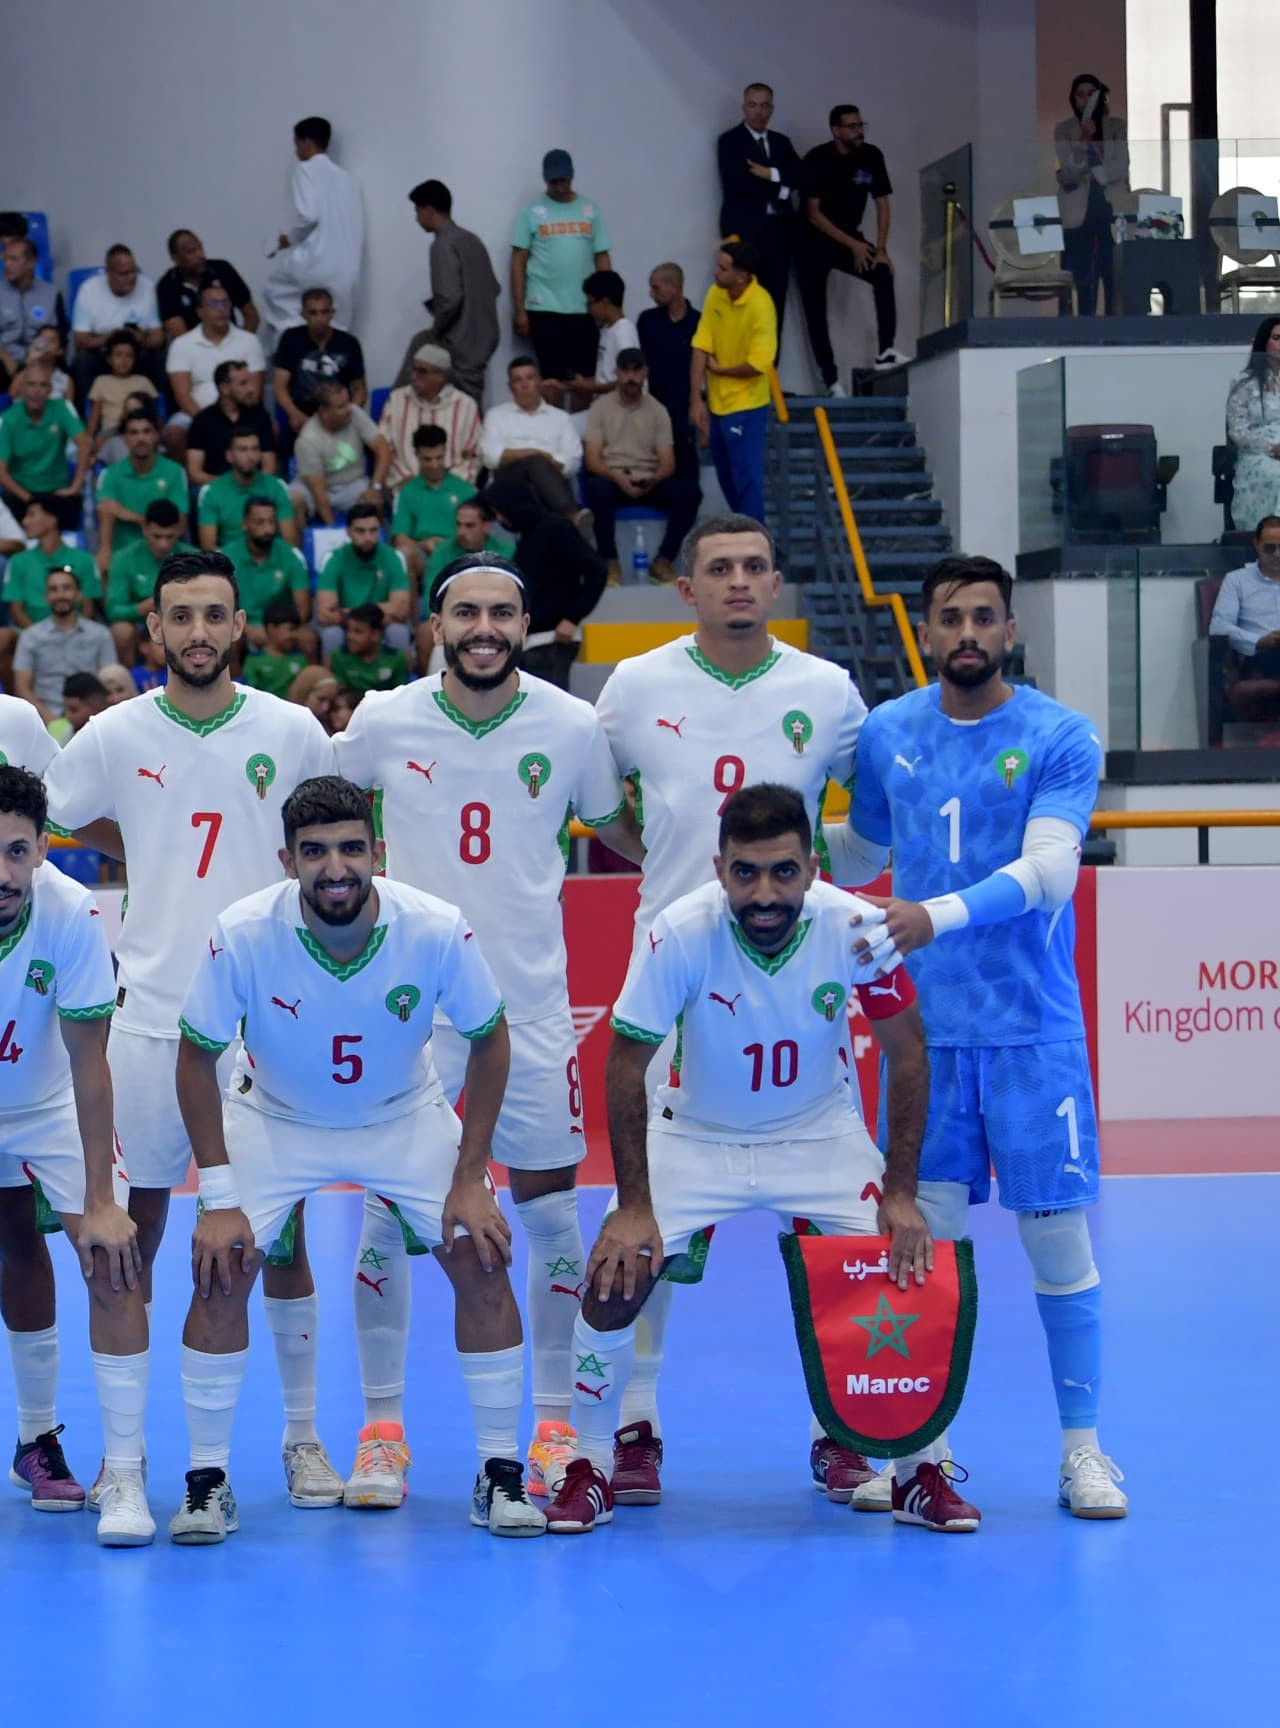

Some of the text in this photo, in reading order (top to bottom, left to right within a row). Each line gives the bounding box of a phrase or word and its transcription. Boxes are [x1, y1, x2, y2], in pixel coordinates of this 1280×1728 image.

[713, 754, 745, 817] 9
[190, 811, 224, 879] 7
[459, 801, 492, 865] 8
[939, 797, 960, 863] 1
[1198, 959, 1279, 991] MOR
[1125, 996, 1263, 1043] Kingdom
[331, 1034, 364, 1085] 5
[566, 1055, 583, 1118] 8
[742, 1039, 799, 1093] 10
[1055, 1096, 1080, 1160] 1
[845, 1373, 930, 1395] Maroc
